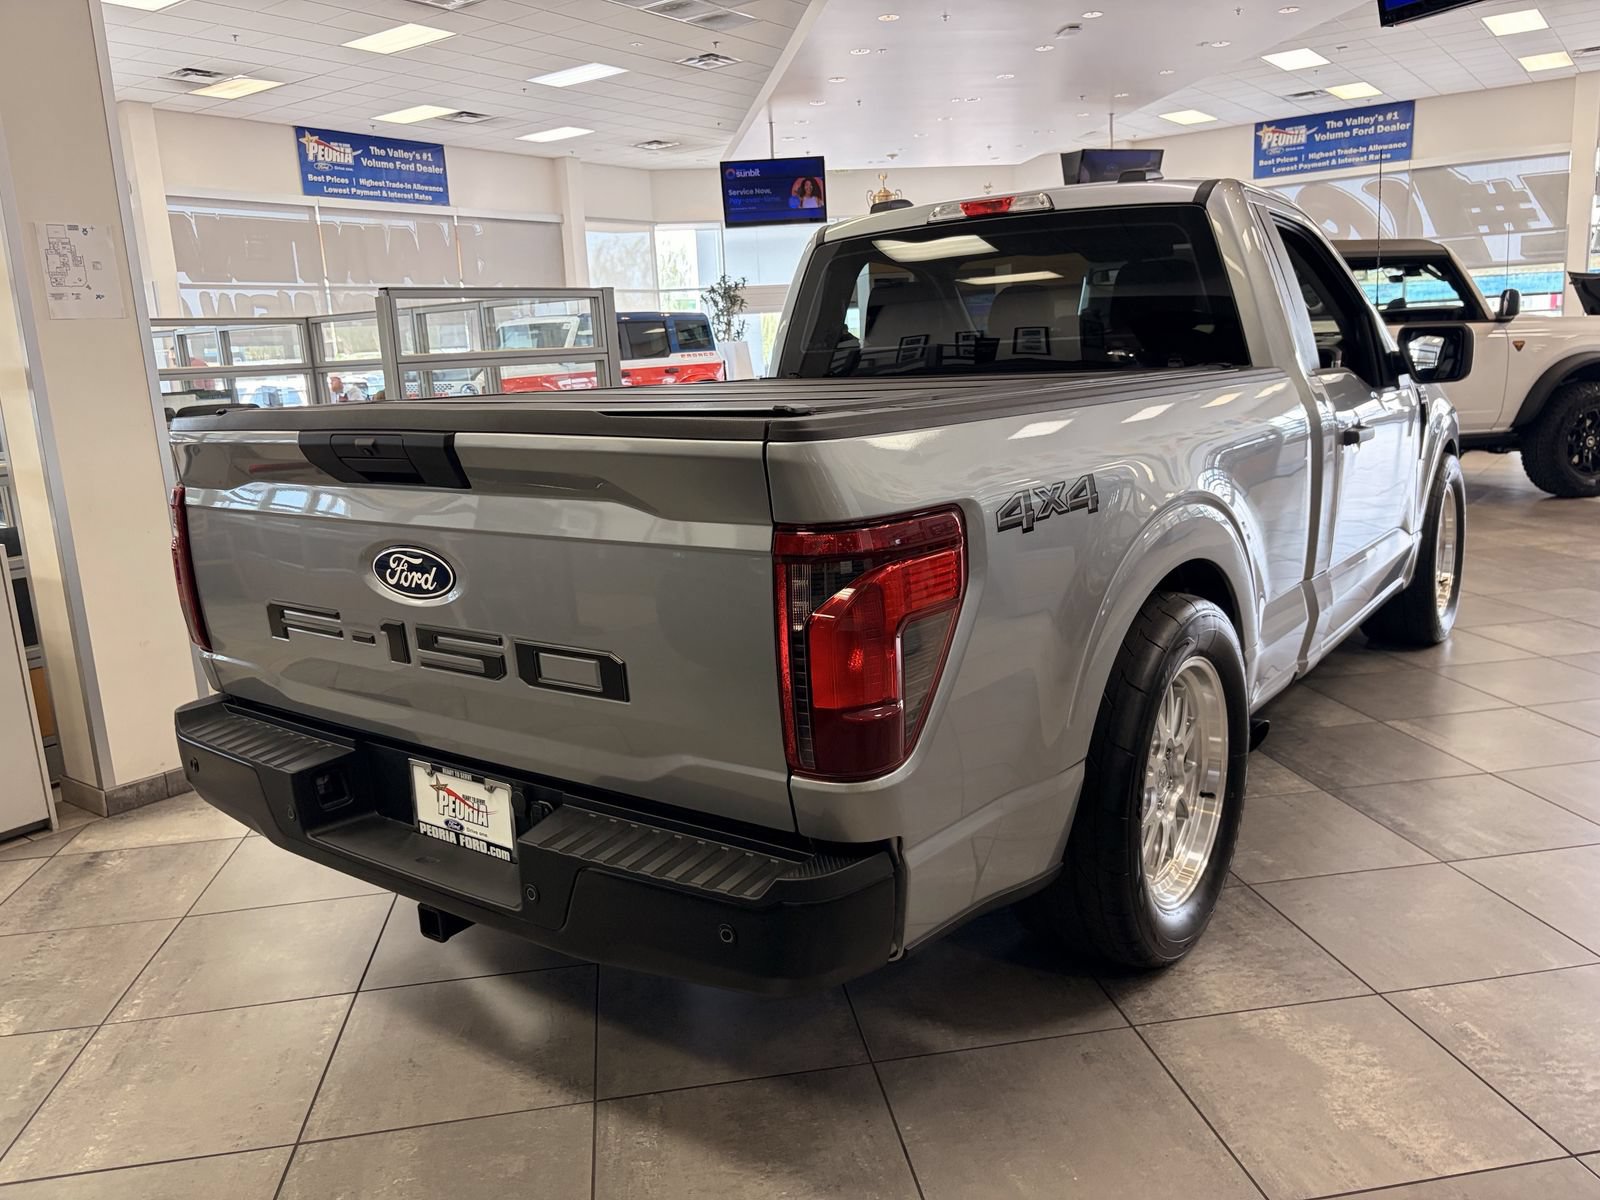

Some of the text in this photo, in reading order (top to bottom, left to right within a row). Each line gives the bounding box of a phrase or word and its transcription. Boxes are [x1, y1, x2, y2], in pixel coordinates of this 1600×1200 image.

[1325, 111, 1399, 129] The Valley's #1
[1314, 122, 1411, 142] Volume Ford Dealer
[369, 146, 433, 162] The Valley's #1
[1259, 142, 1407, 166] Best Prices Highest Trade-In Allowance
[360, 158, 444, 174] Volume Ford Dealer
[1272, 164, 1297, 173] Lowest
[1298, 160, 1329, 170] Payment
[1338, 154, 1367, 164] Interest
[736, 168, 760, 178] sunbit
[308, 174, 444, 192] Best Prices Highest Trade-In Allowance
[728, 188, 754, 196] Service
[324, 186, 432, 200] Lowest Payment & Interest Rates
[386, 553, 438, 592] Ford
[266, 599, 631, 704] F-150
[438, 790, 488, 828] PEORIA
[420, 822, 510, 862] PEORIA FORD.com
